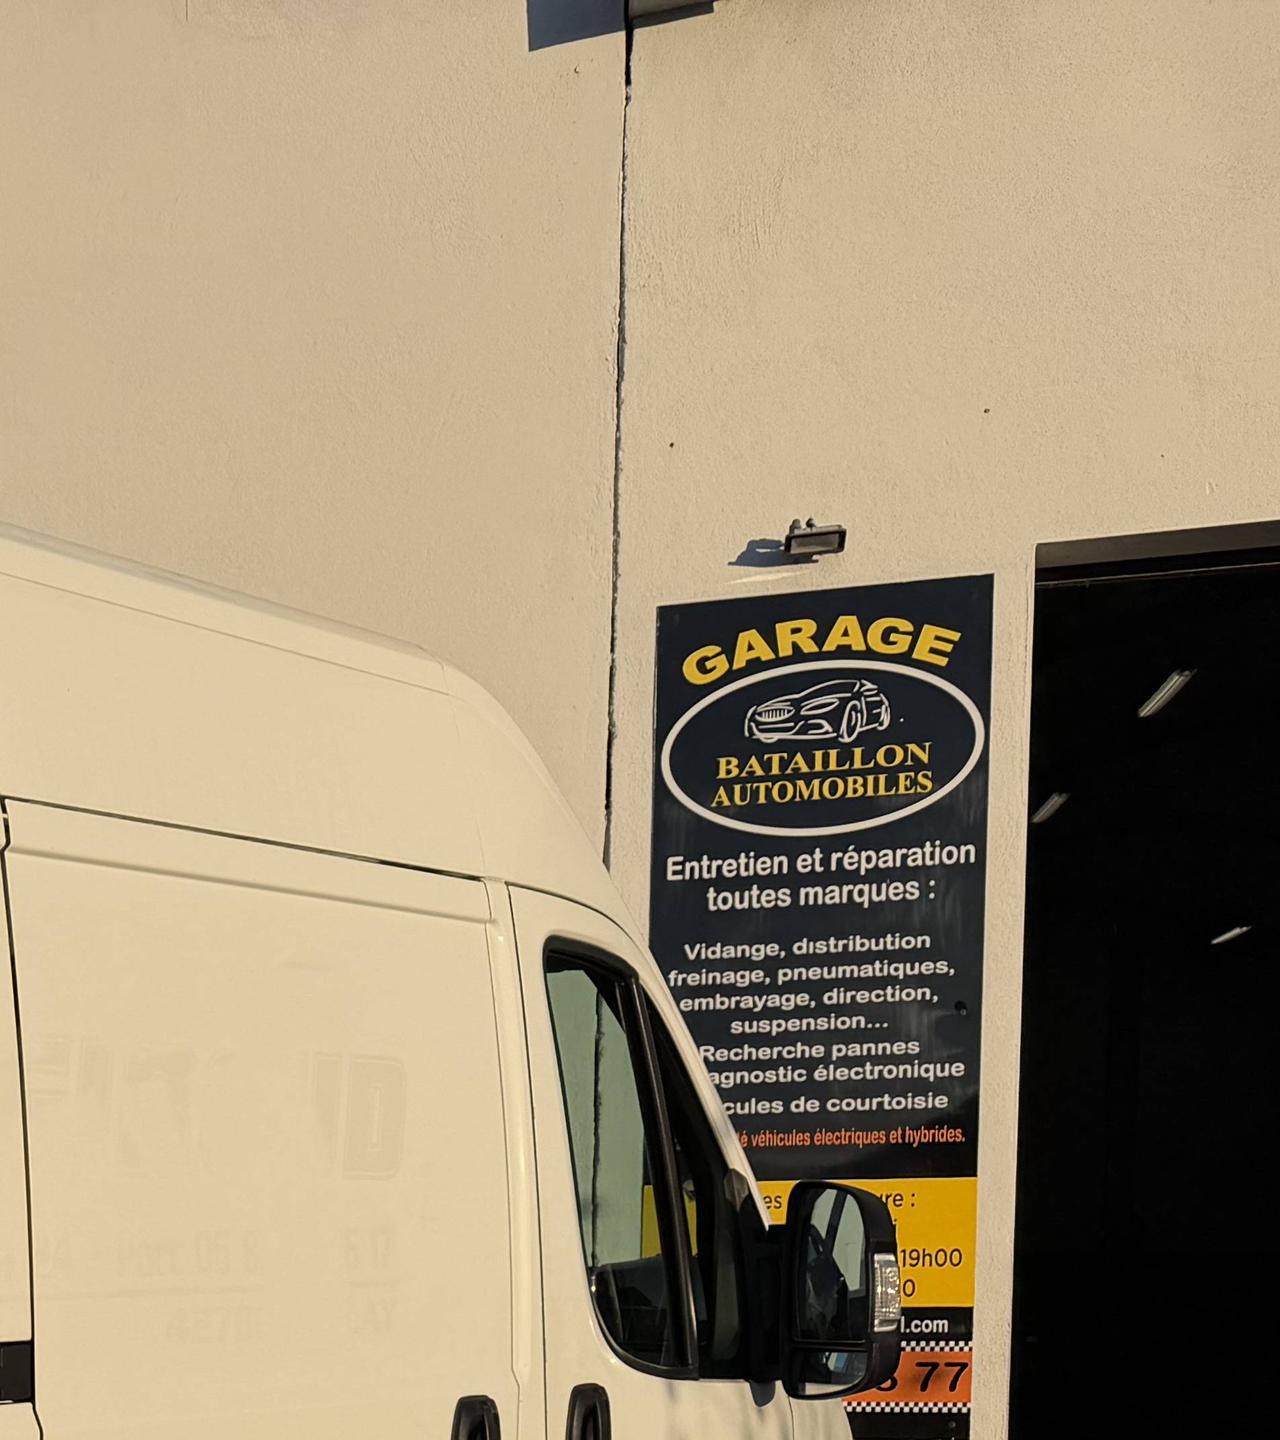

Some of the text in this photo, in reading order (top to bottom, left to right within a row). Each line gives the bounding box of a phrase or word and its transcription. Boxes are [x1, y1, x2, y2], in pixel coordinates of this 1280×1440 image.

[682, 615, 962, 685] GARAGE
[715, 741, 933, 780] BATAILLON
[711, 770, 934, 807] AUTOMOBILES
[666, 841, 976, 881] Entretien et réparation
[706, 885, 791, 911] toutes
[799, 879, 920, 908] marques
[684, 932, 931, 961] Vidange, distribution
[668, 959, 955, 988] freinage, pneumatiques,
[679, 984, 938, 1012] embrayage, direction,
[730, 1013, 889, 1036] suspension...
[699, 1039, 920, 1063] Recherche pannes
[709, 1060, 966, 1088] agnostic électronique
[722, 1091, 949, 1115] cules de courtoisie
[752, 1128, 810, 1147] véhicules
[814, 1127, 886, 1149] électriques
[889, 1128, 902, 1144] et
[905, 1125, 965, 1148] hybrides.
[915, 1362, 969, 1393] 77
